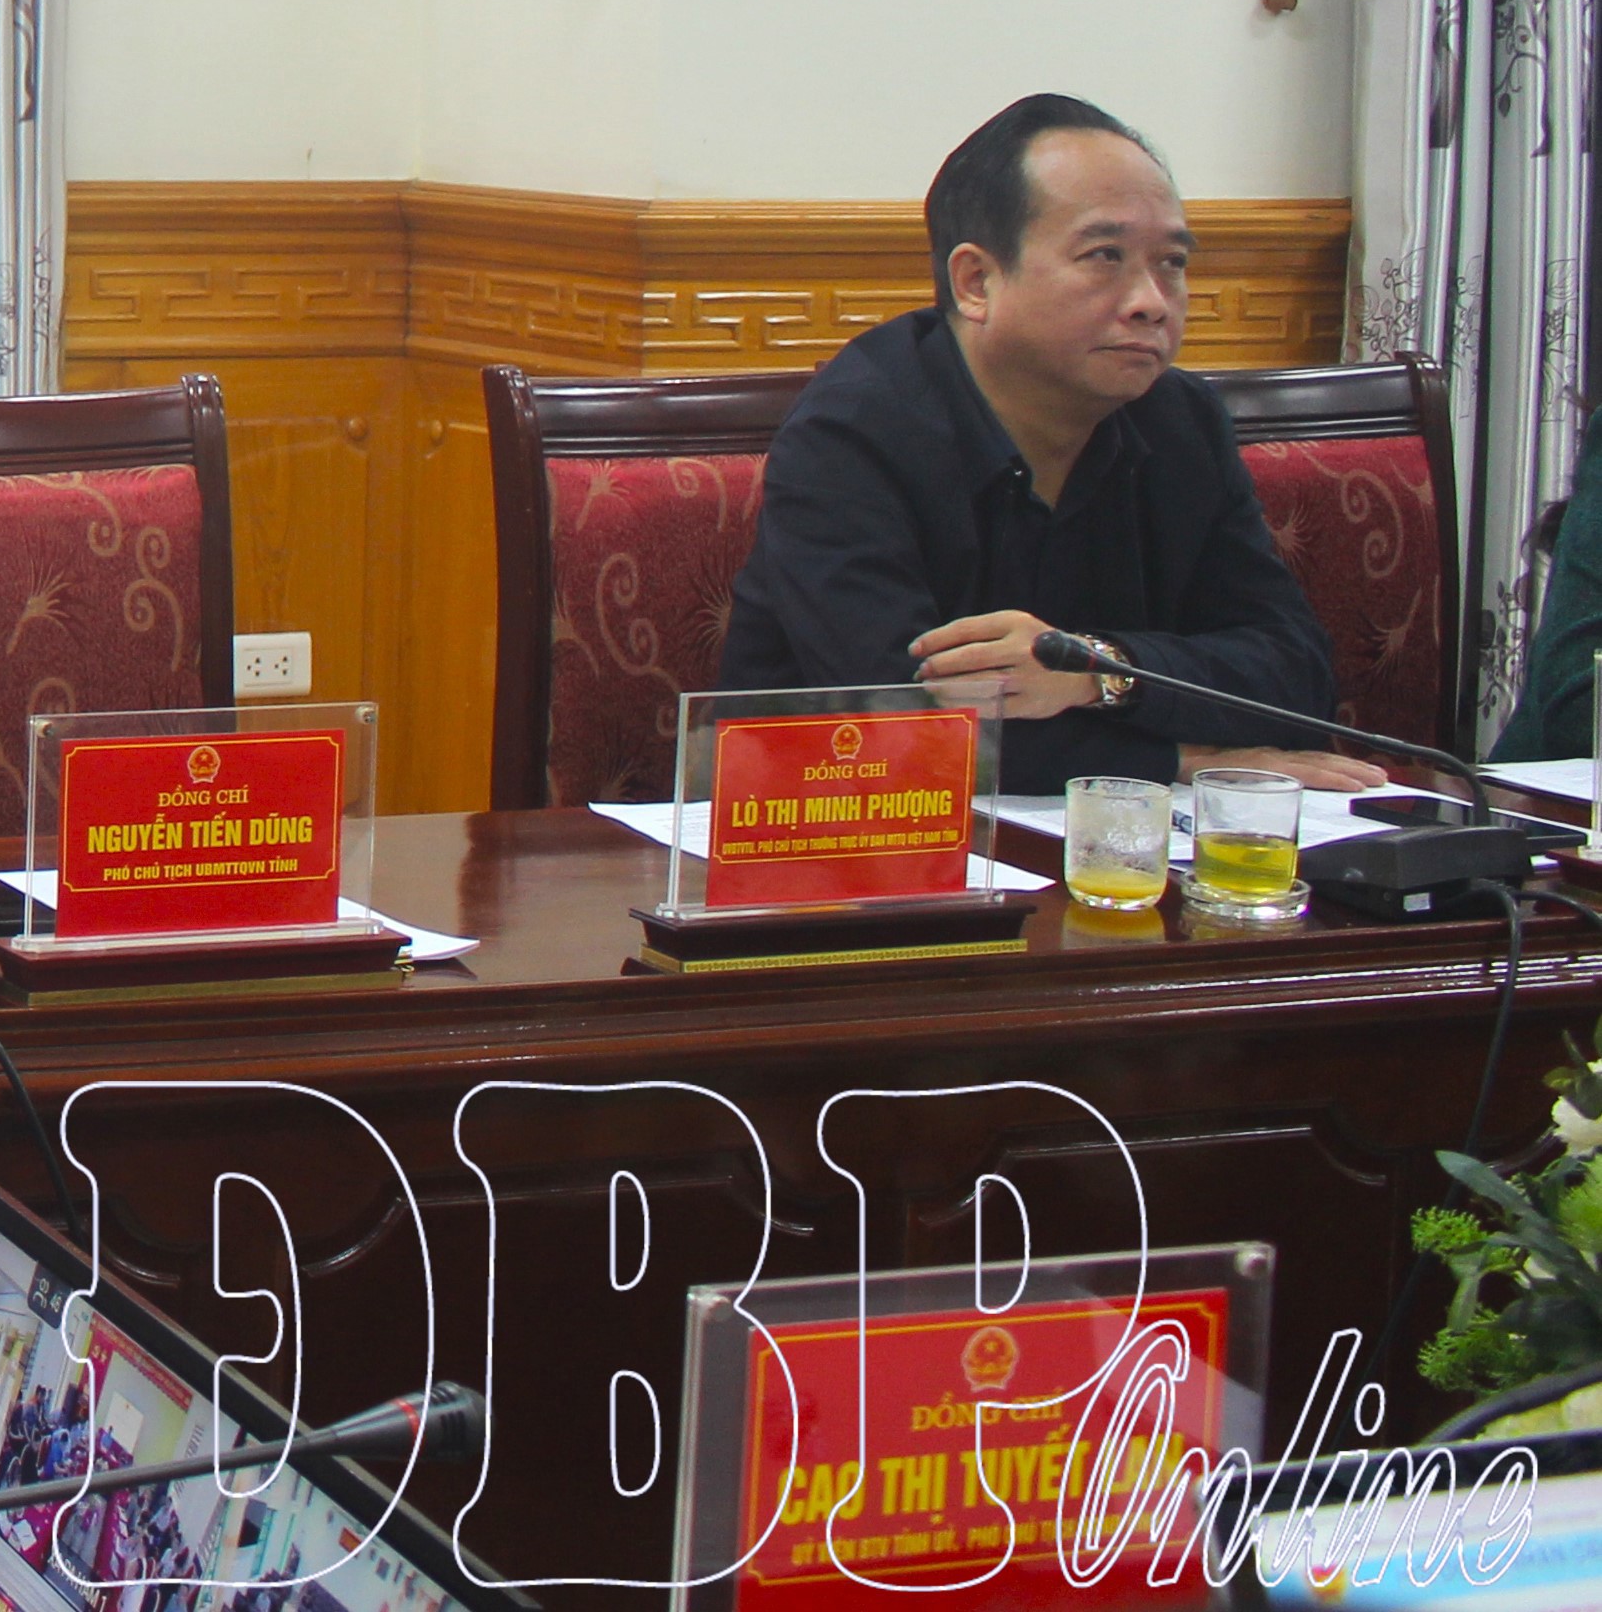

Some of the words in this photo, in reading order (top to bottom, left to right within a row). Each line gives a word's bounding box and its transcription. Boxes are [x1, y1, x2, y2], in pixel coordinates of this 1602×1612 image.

[804, 759, 853, 780] ĐỒNG
[858, 759, 888, 778] CHÍ
[158, 784, 211, 807] ĐỒNG
[217, 785, 249, 805] CHÍ
[732, 795, 758, 827] LÒ
[765, 799, 798, 830] THỊ
[805, 795, 861, 823] MINH
[868, 790, 952, 823] PHƯỢNG
[89, 814, 183, 853] NGUYỄN
[191, 811, 242, 848] TIẾN
[250, 813, 313, 845] DŨNG
[103, 863, 129, 881] PHÓ
[134, 861, 160, 880] CHỦ
[164, 863, 192, 881] TỊCH
[196, 861, 265, 877] UBMTTQVN
[269, 856, 298, 873] TỈNH
[911, 1391, 1000, 1432] ĐỒNG
[778, 1466, 865, 1527] CAO
[880, 1456, 946, 1525] THỊ
[962, 1422, 1091, 1509] TUYẾT
